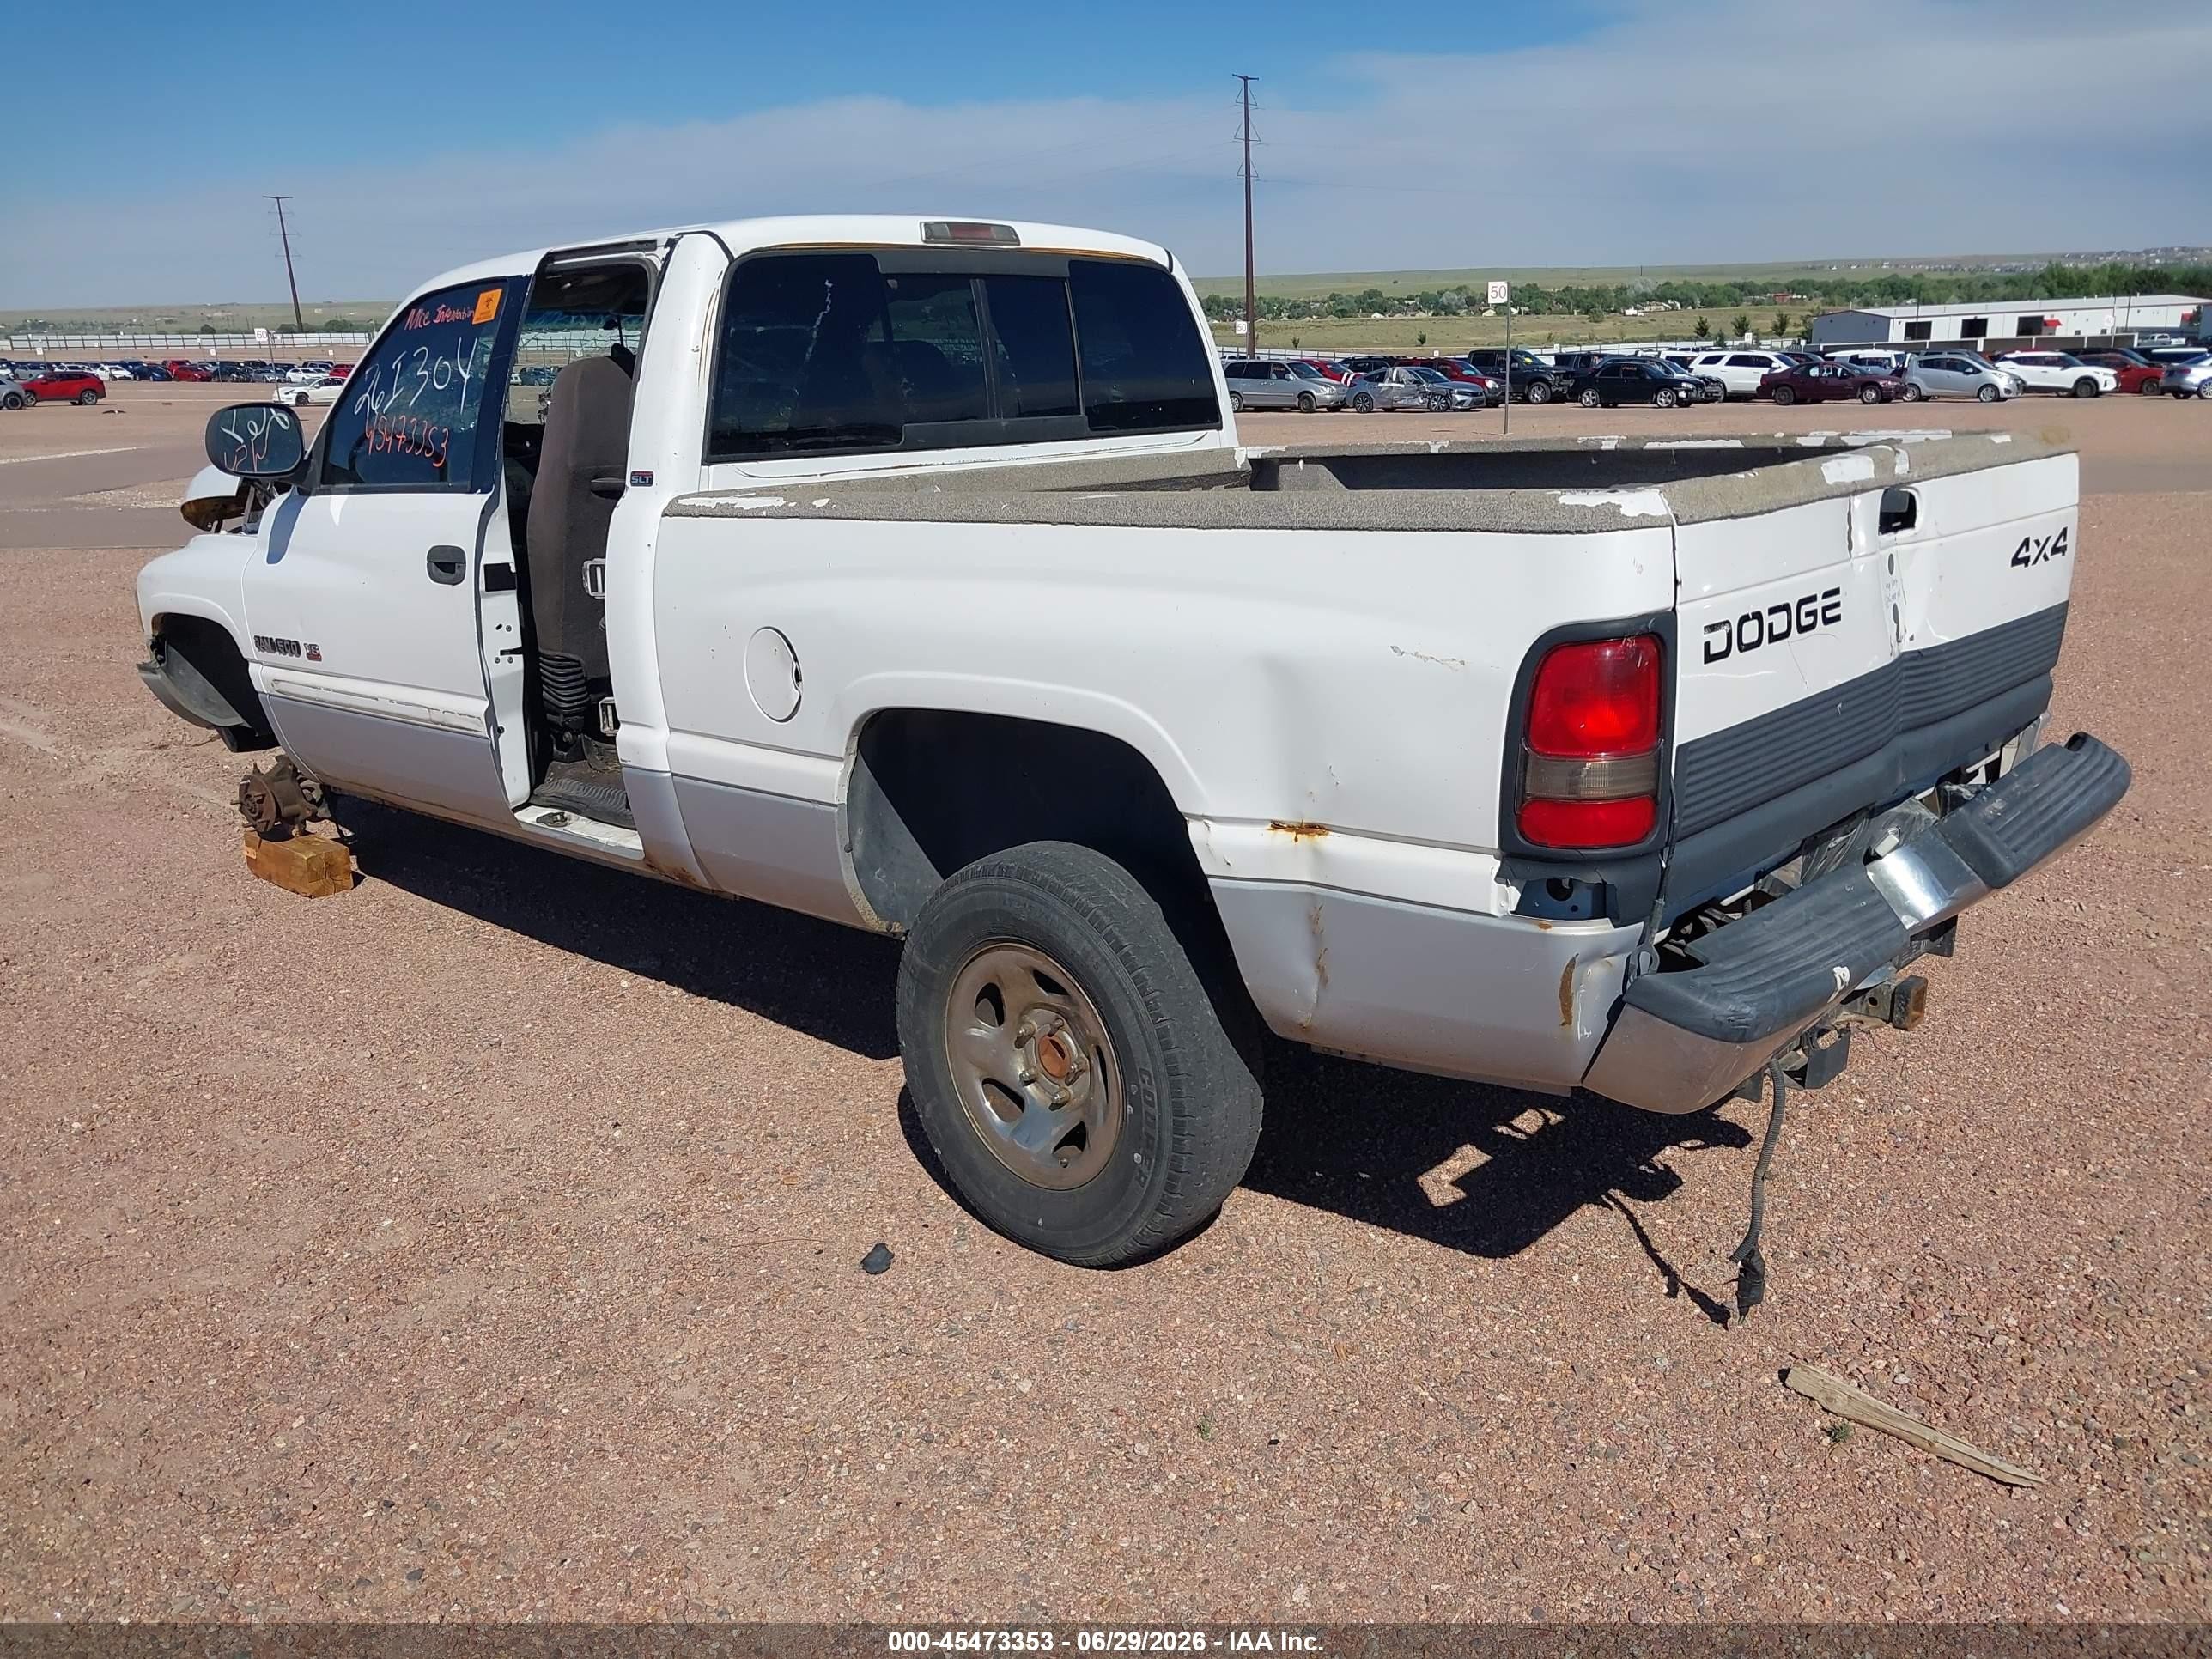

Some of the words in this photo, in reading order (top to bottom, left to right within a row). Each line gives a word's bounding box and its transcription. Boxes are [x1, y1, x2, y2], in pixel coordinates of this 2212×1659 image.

[1491, 285, 1507, 299] 50
[631, 475, 653, 484] SLT
[1704, 586, 1841, 665] DODGE
